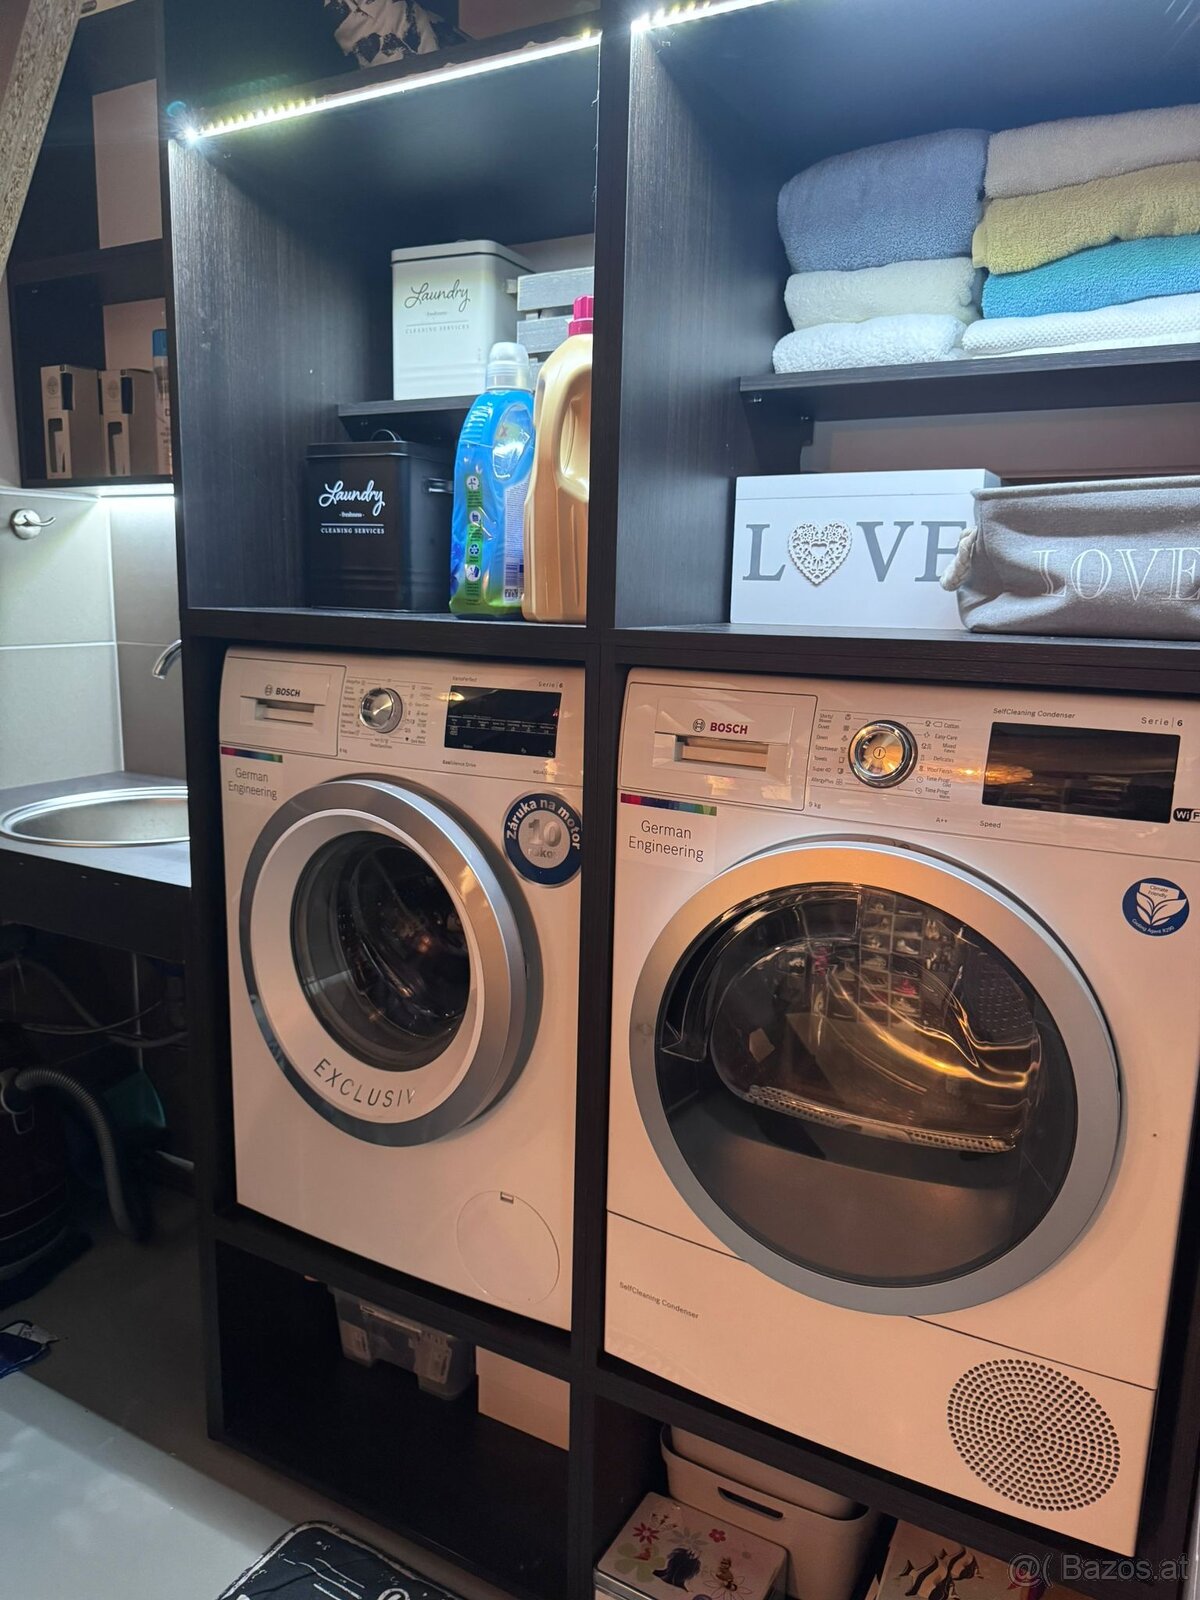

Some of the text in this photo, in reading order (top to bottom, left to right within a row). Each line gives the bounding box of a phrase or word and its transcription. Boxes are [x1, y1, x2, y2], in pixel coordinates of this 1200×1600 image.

[404, 279, 470, 312] Laundry
[319, 480, 385, 516] Laundry
[1032, 547, 1200, 601] LOVE
[276, 687, 301, 697] BOSCH
[993, 707, 1076, 719] SelfCleaning Condenser
[1141, 716, 1184, 727] Serie 6
[710, 722, 748, 735] BOSCH
[235, 767, 269, 782] German
[228, 781, 278, 801] Engineering
[506, 800, 581, 850] Záruka na motor
[528, 819, 562, 847] 10
[640, 819, 692, 839] German
[980, 820, 1001, 829] Speed
[629, 835, 704, 862] Engineering
[619, 1281, 699, 1319] SelfCleaning Condenser
